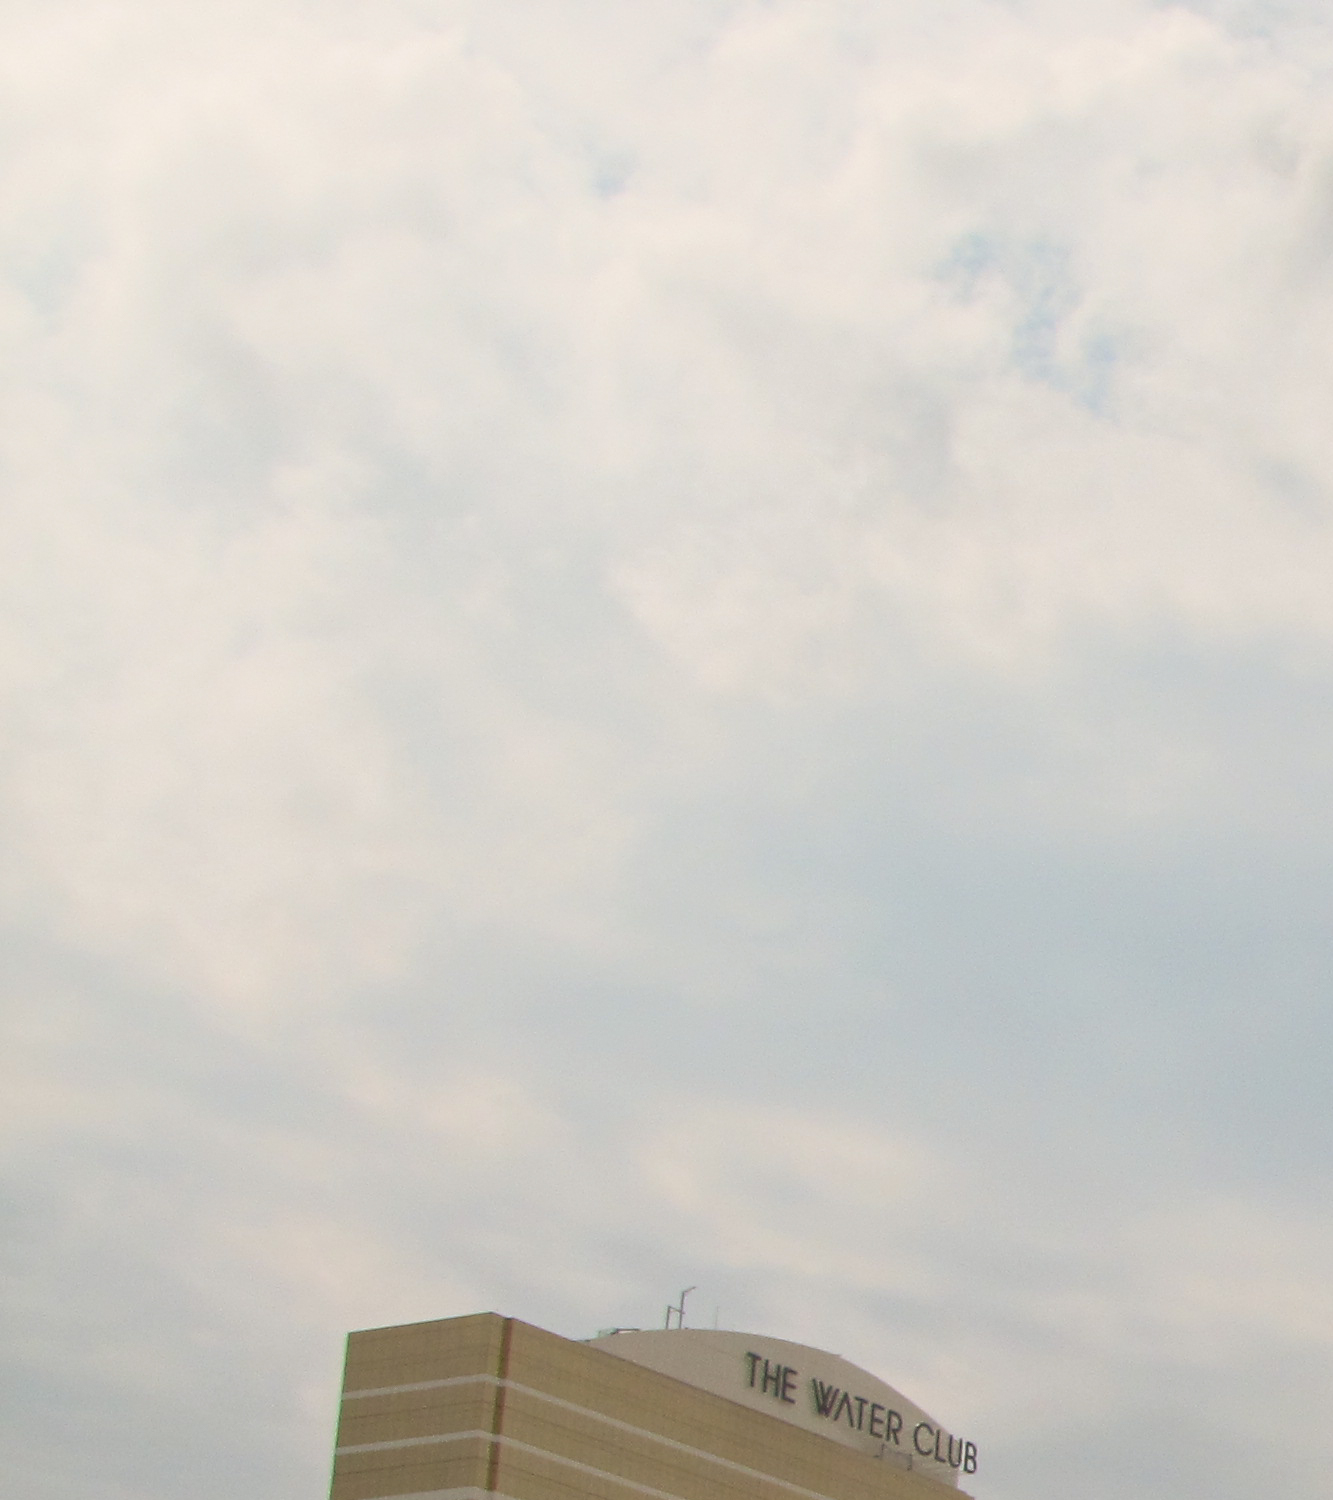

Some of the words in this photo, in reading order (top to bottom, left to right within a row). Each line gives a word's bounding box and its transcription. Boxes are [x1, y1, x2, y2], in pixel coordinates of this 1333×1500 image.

[746, 1351, 798, 1404] THE
[811, 1378, 903, 1445] WATER
[913, 1421, 977, 1474] CLUB
